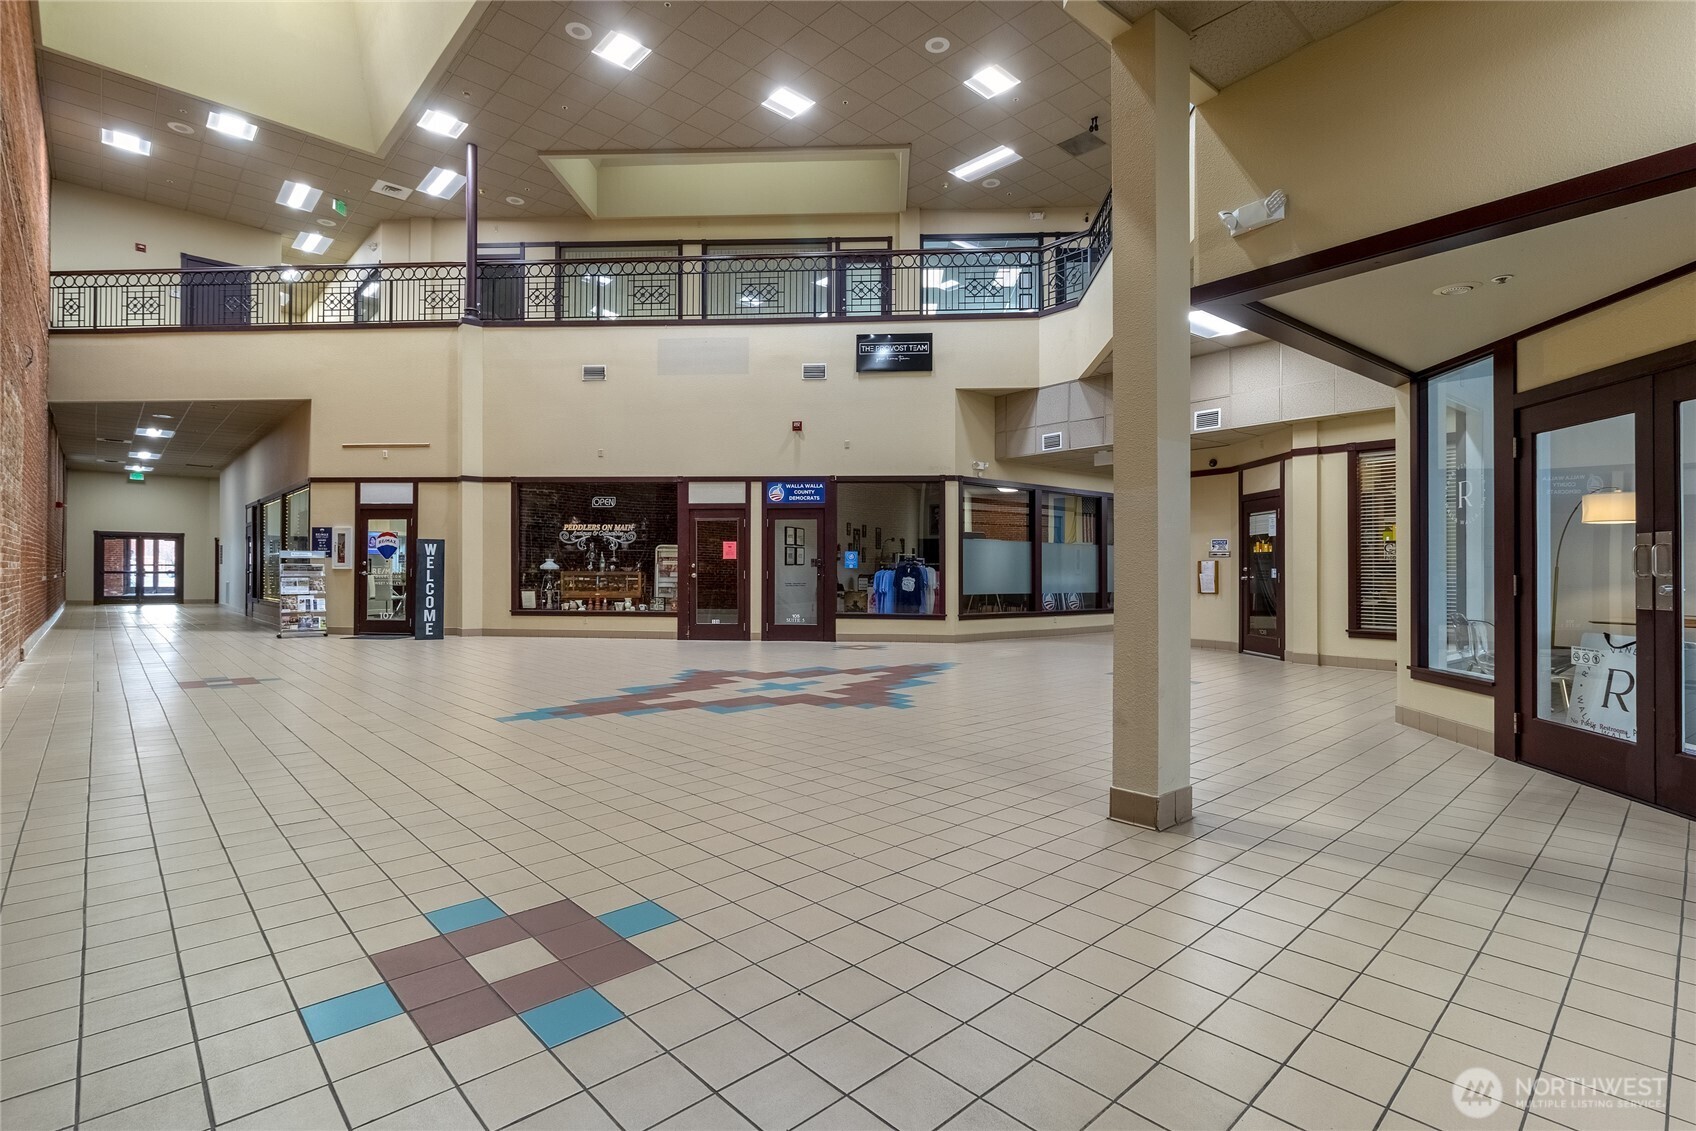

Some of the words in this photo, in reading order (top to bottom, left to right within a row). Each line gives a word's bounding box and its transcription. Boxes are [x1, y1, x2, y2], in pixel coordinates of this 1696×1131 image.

[593, 498, 615, 506] OPEN
[1458, 480, 1473, 509] R
[562, 523, 601, 531] PEDDLERS
[423, 543, 438, 636] WELCOME
[1601, 667, 1635, 713] R
